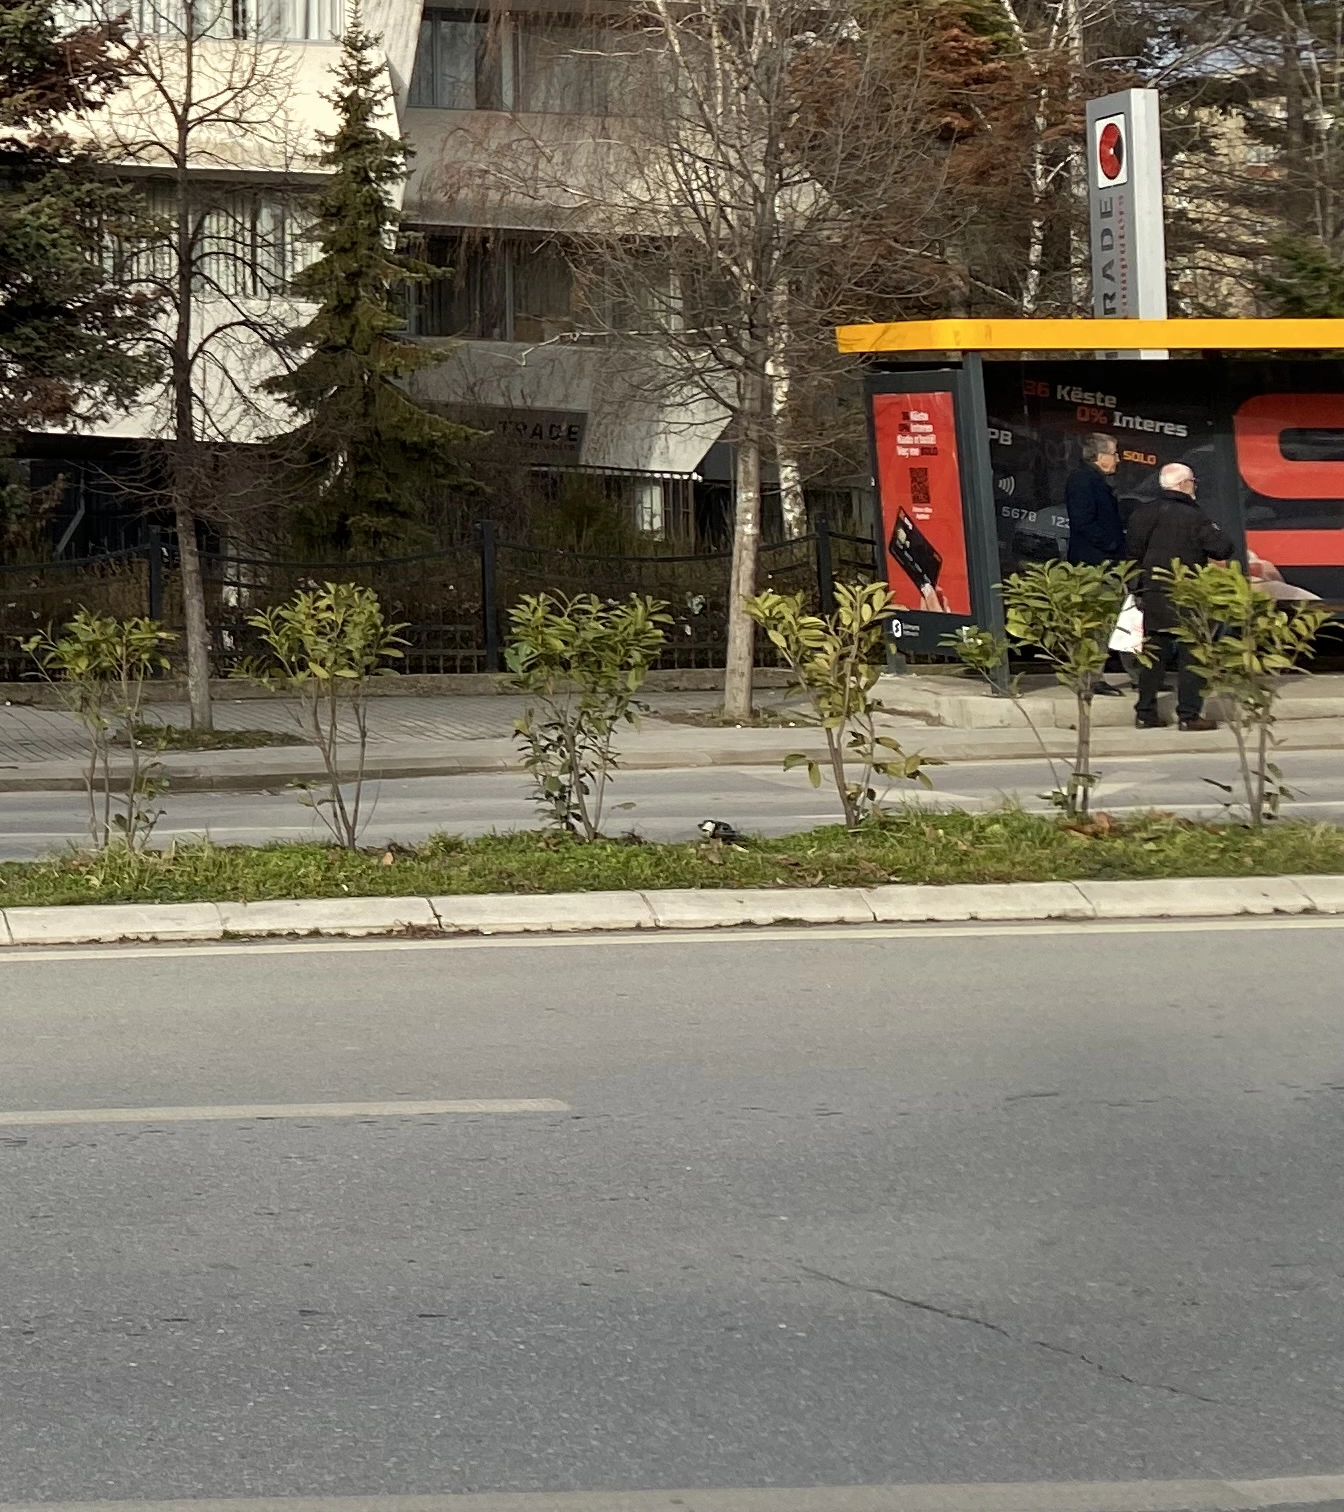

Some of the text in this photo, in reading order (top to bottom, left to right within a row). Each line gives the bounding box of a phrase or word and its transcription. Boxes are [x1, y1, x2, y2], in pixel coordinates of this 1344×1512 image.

[1057, 384, 1117, 408] Këste
[1076, 405, 1188, 438] 0% Interes
[1123, 450, 1157, 466] SOLO
[1002, 506, 1037, 523] 5678
